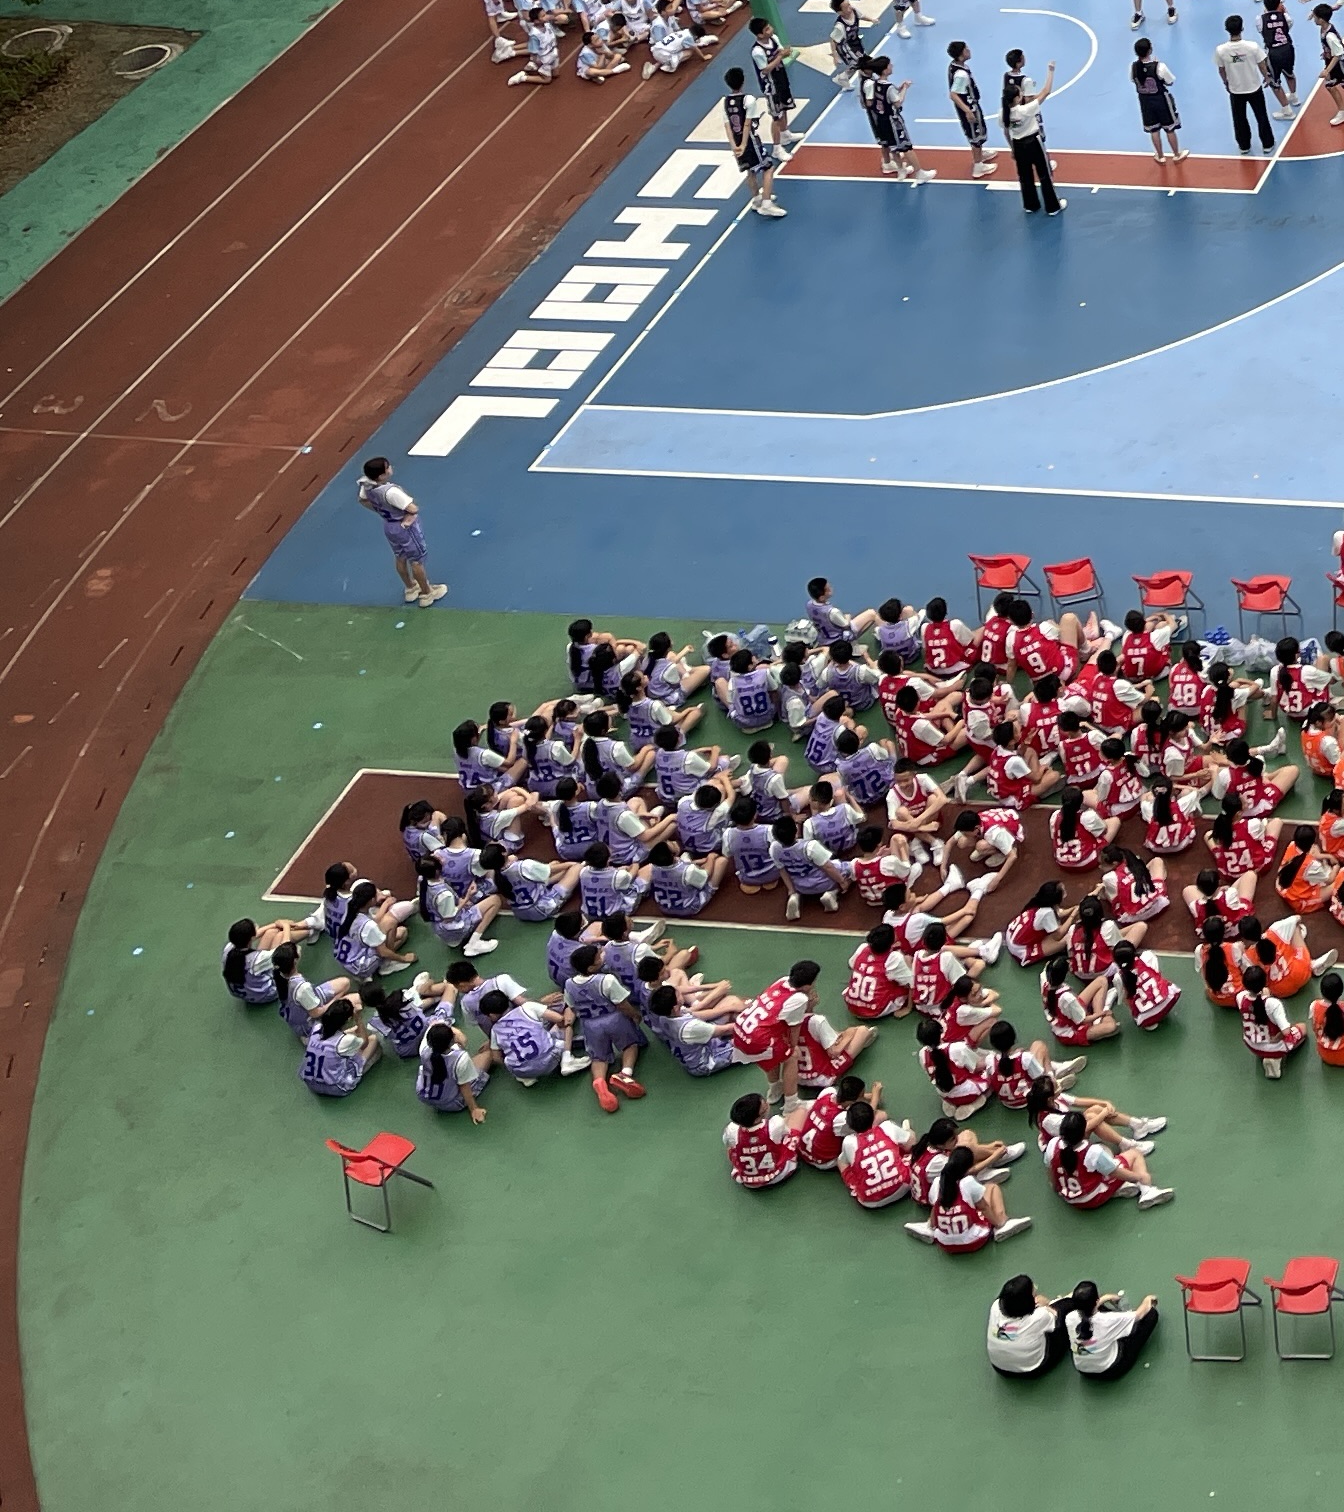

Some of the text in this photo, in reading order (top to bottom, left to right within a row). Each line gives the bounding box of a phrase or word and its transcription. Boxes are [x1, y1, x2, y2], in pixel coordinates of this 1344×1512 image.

[931, 648, 946, 666] 2
[1029, 652, 1042, 673] 9
[1131, 657, 1144, 676] 7
[739, 692, 768, 713] 88
[1172, 683, 1196, 706] 48
[1056, 839, 1081, 862] 23
[1228, 849, 1252, 870] 24
[741, 854, 766, 872] 13
[850, 976, 875, 1002] 30
[1135, 985, 1163, 1012] 27
[736, 1001, 766, 1034] 26
[512, 1032, 539, 1063] 15
[304, 1054, 326, 1079] 31
[740, 1151, 775, 1175] 34
[865, 1153, 897, 1184] 32
[938, 1215, 968, 1237] 50
